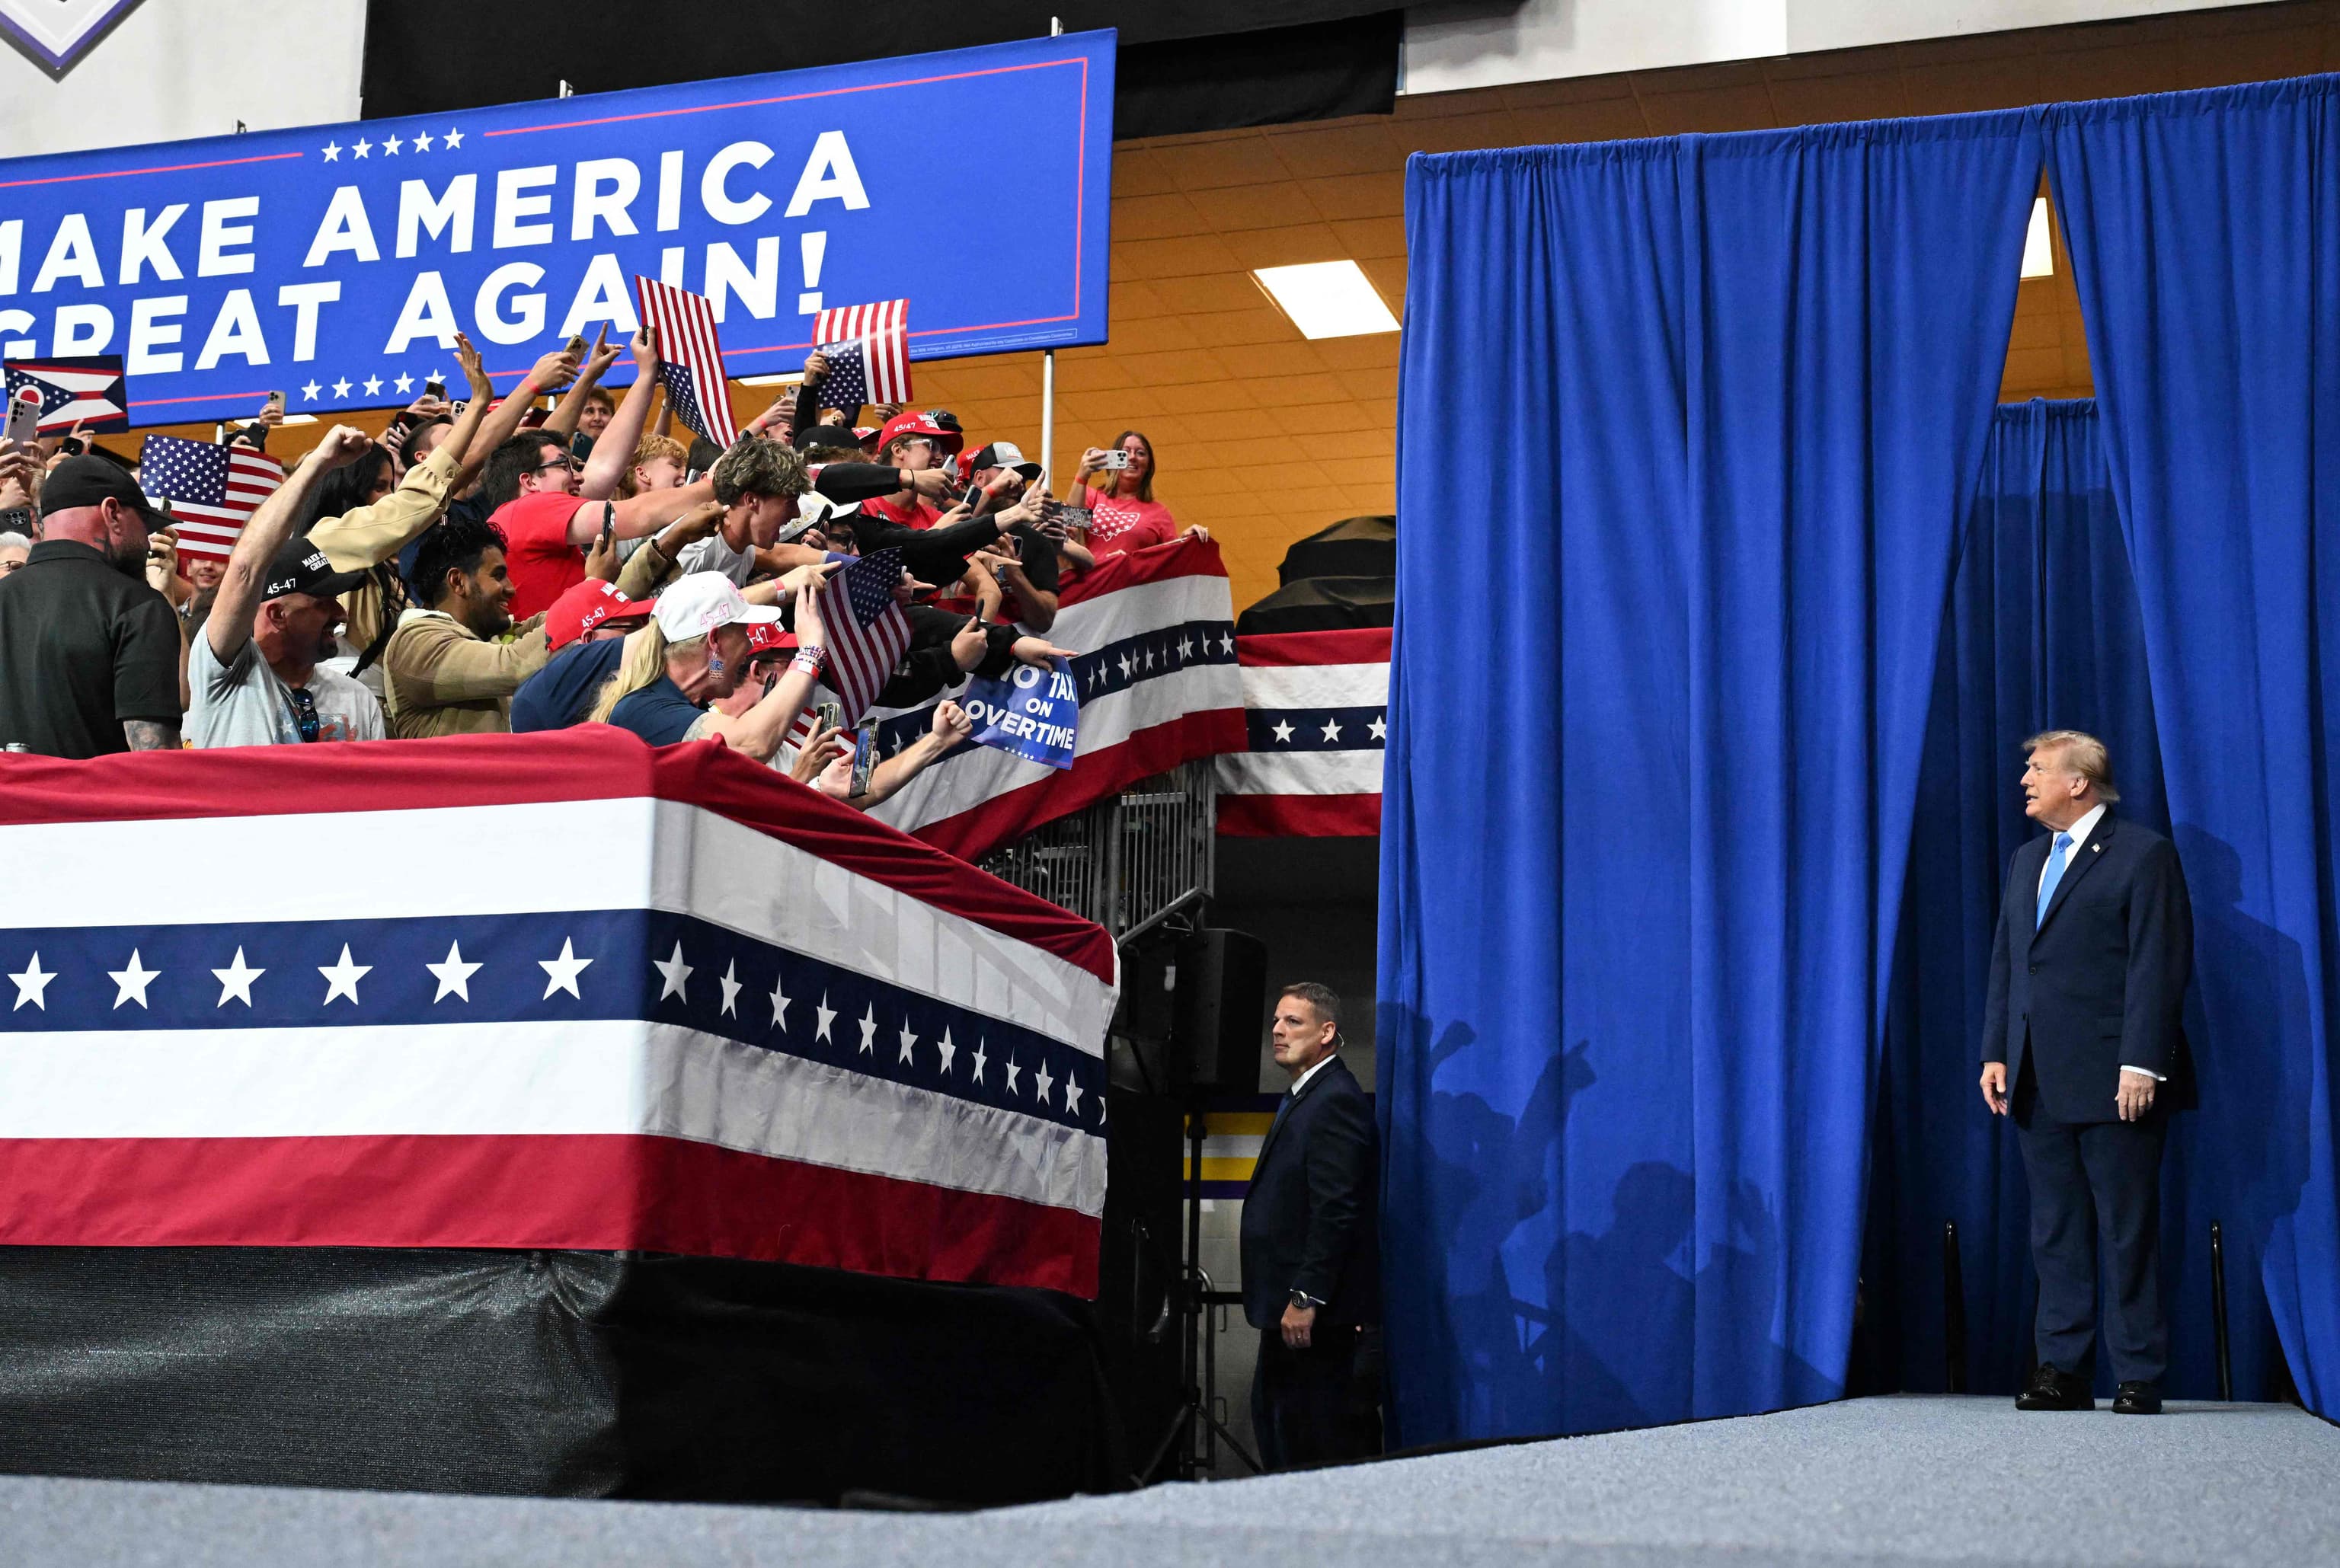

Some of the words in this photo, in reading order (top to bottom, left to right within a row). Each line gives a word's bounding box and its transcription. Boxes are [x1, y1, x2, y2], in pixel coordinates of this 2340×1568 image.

[302, 129, 871, 268] AMERICA
[893, 422, 916, 433] 45/47
[267, 577, 296, 595] 45-47
[581, 606, 606, 628] 45-47
[699, 602, 731, 629] 45-47
[746, 626, 769, 647] -47
[1048, 671, 1076, 702] TAX
[1025, 698, 1054, 718] ON
[965, 699, 1075, 750] OVERTIME
